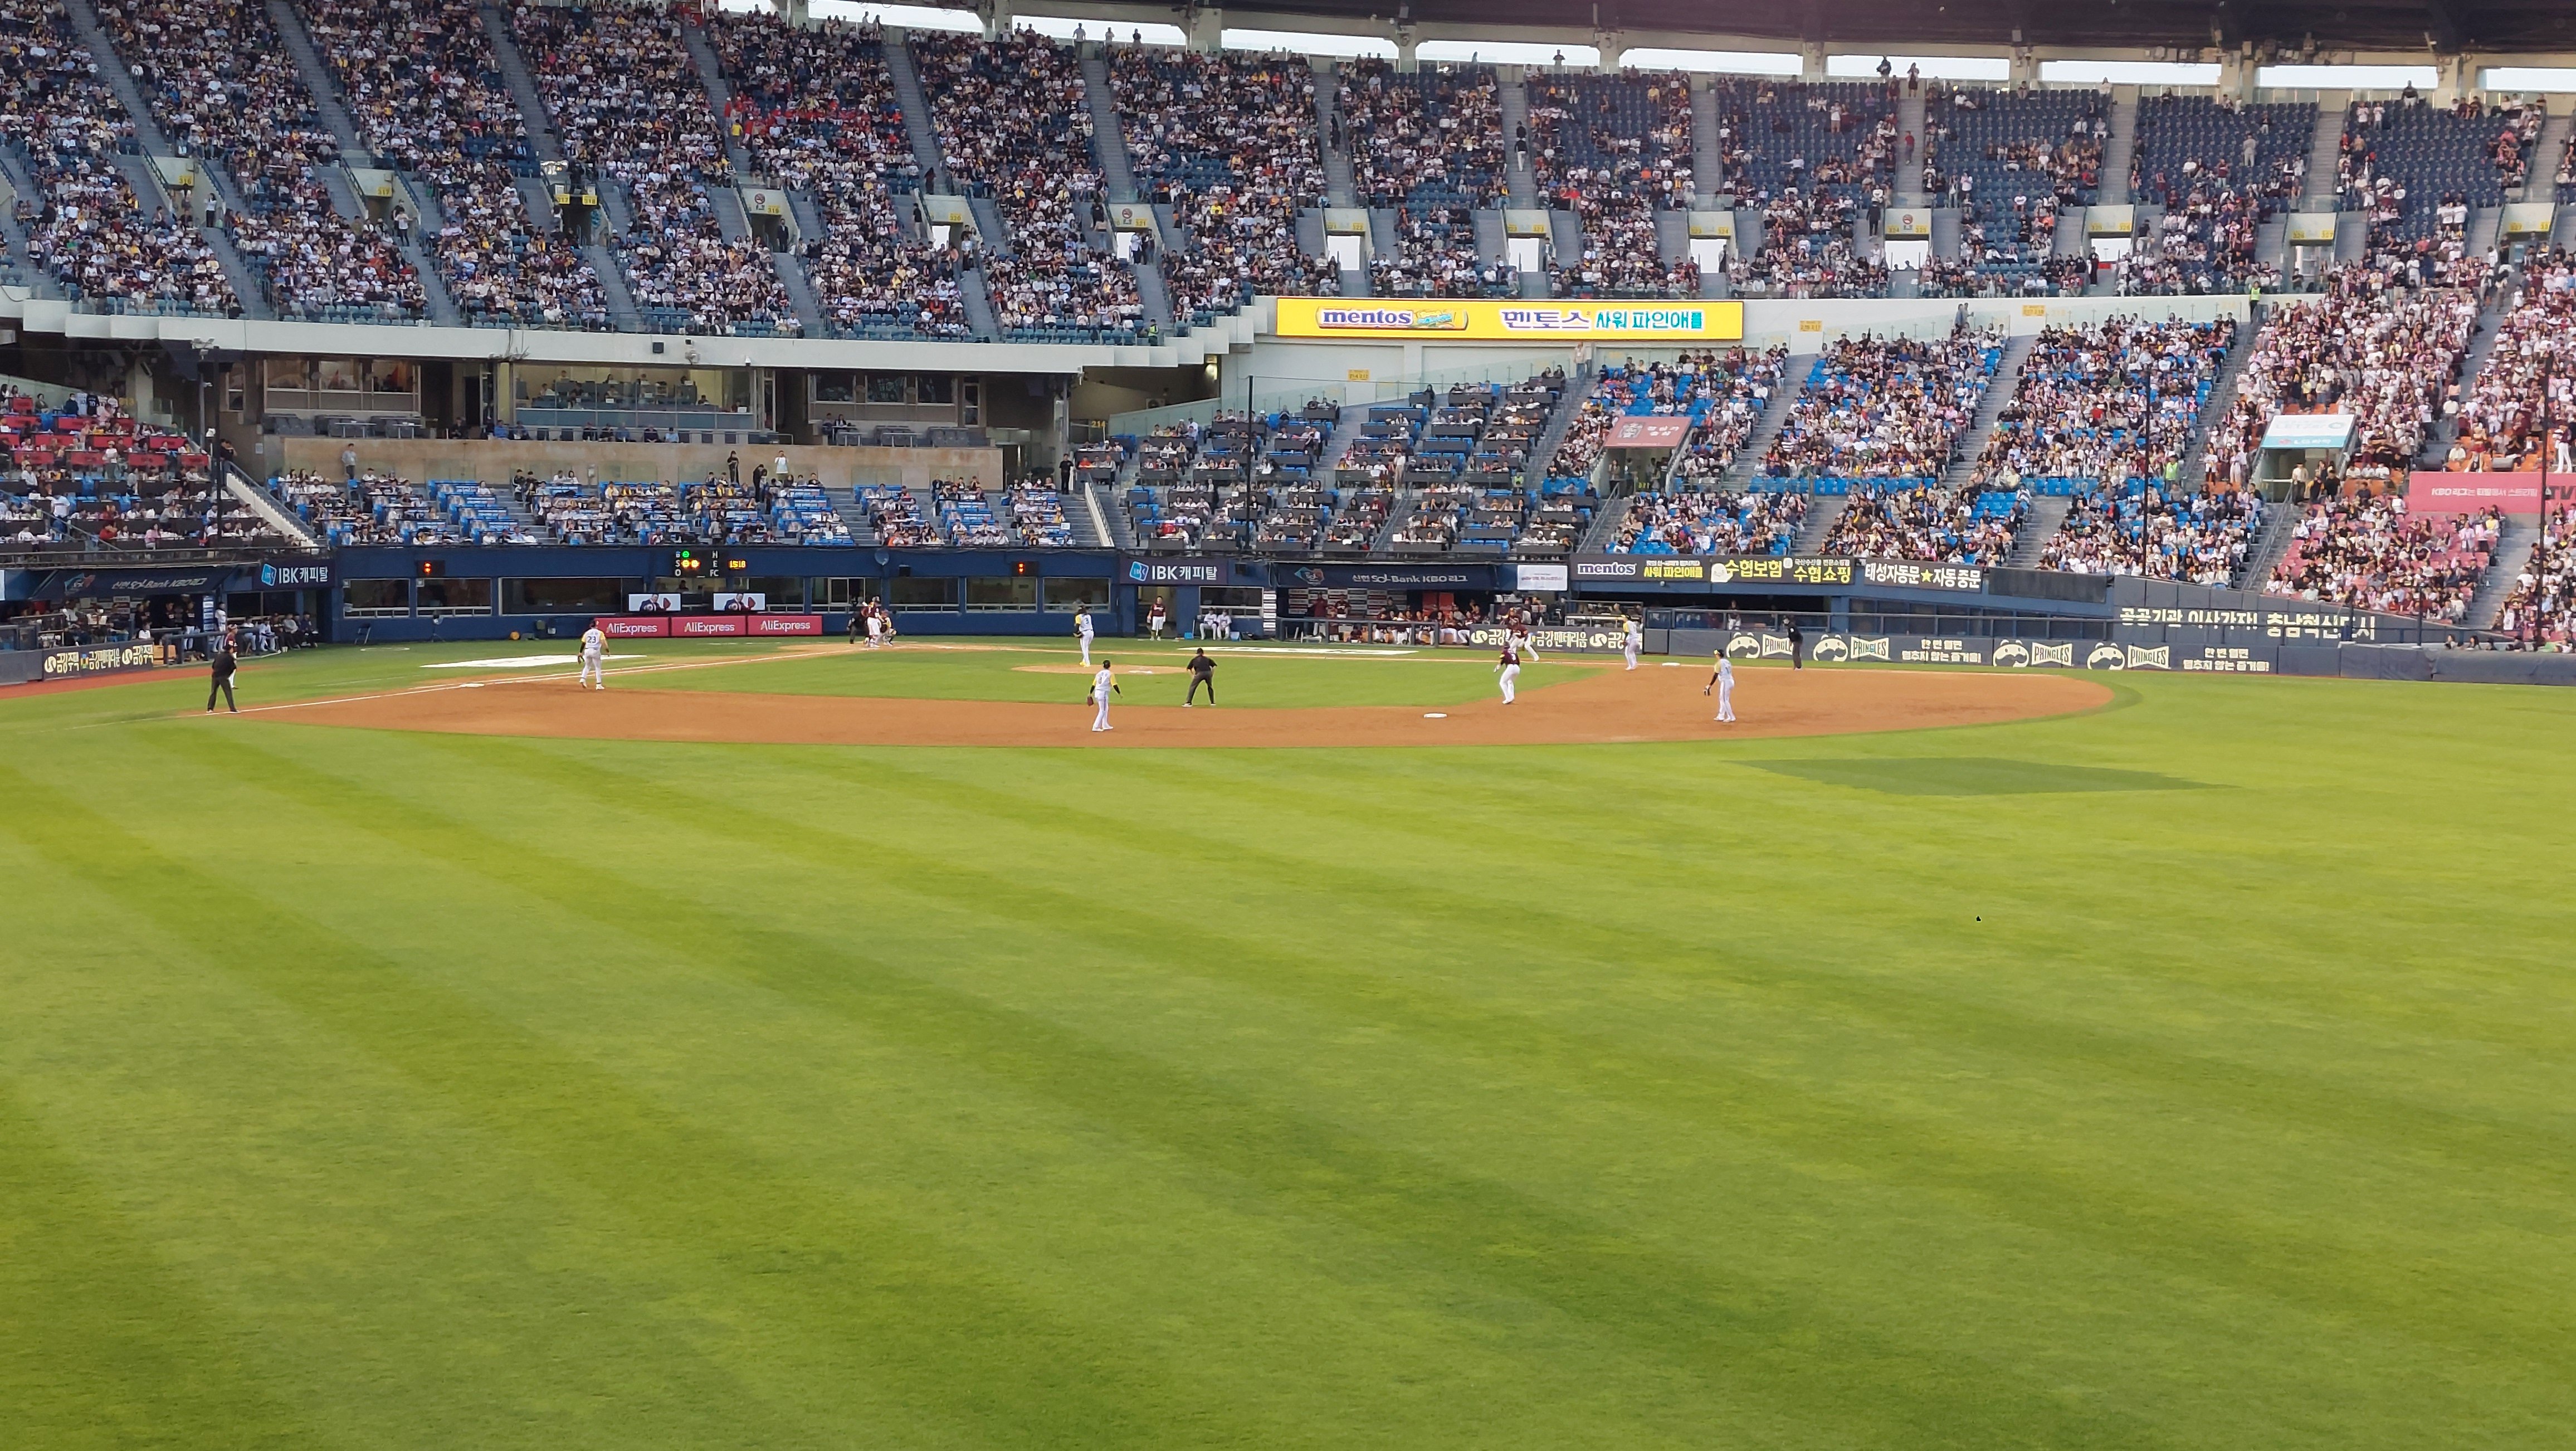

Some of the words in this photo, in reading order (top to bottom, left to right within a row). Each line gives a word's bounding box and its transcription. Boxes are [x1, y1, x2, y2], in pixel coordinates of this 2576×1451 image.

[1323, 310, 1412, 324] mentos
[1501, 311, 1589, 329] 멘토스
[1596, 311, 1627, 329] 사워
[2431, 488, 2452, 496] KBO
[2548, 485, 2576, 500] TV
[1578, 562, 1636, 574] mentos
[1644, 567, 1662, 577] 사워
[1725, 559, 1782, 578] 수협보험
[1865, 562, 1920, 585] 태성자동문
[2120, 608, 2183, 626] 공공기관
[606, 623, 658, 635] AliExpress
[684, 621, 735, 634] AliExpress
[760, 620, 811, 632] AliExpress
[1536, 631, 1587, 648] 금강펜테리움
[1765, 637, 1793, 653] PRINGLE
[2034, 646, 2070, 663] PRINGLES
[2130, 649, 2167, 666] PRINGLES
